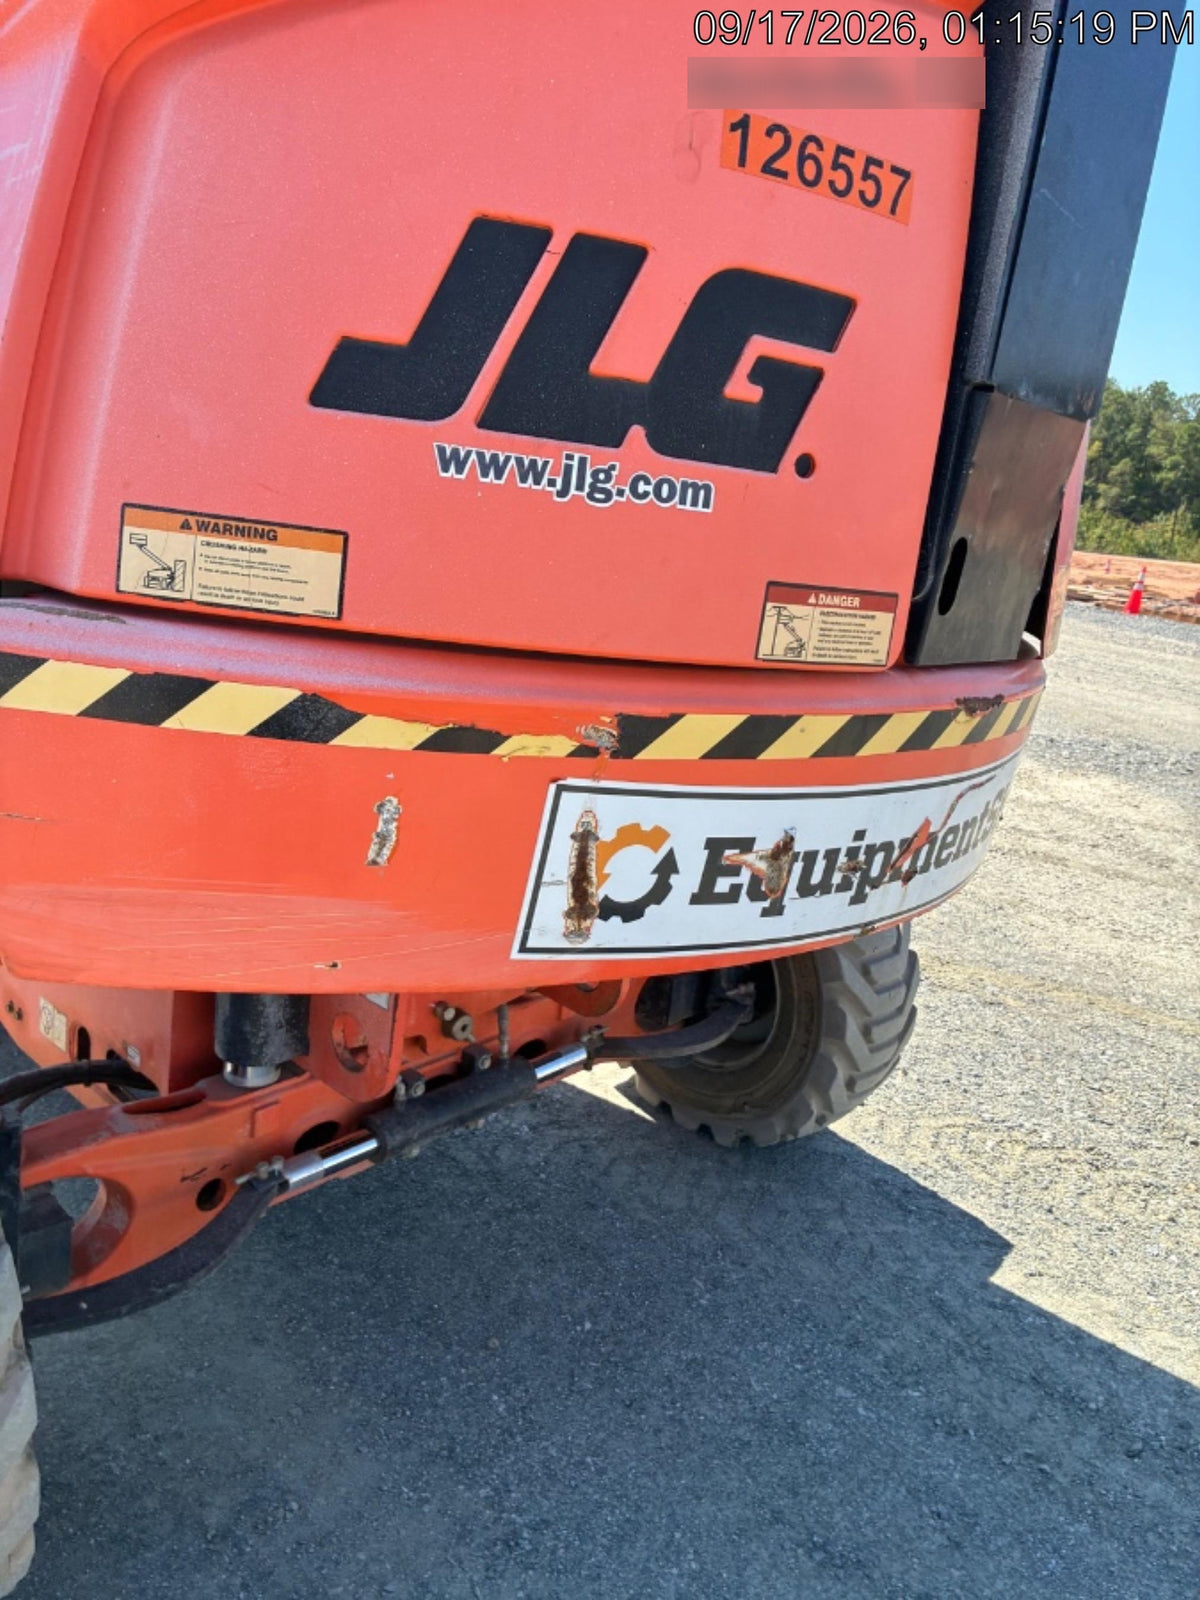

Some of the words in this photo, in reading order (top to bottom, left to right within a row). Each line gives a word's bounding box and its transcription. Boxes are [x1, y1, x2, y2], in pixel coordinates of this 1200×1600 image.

[728, 113, 912, 217] 126557
[434, 443, 714, 512] www.jlg.com
[196, 519, 278, 542] WARNING
[818, 593, 861, 608] DANGER
